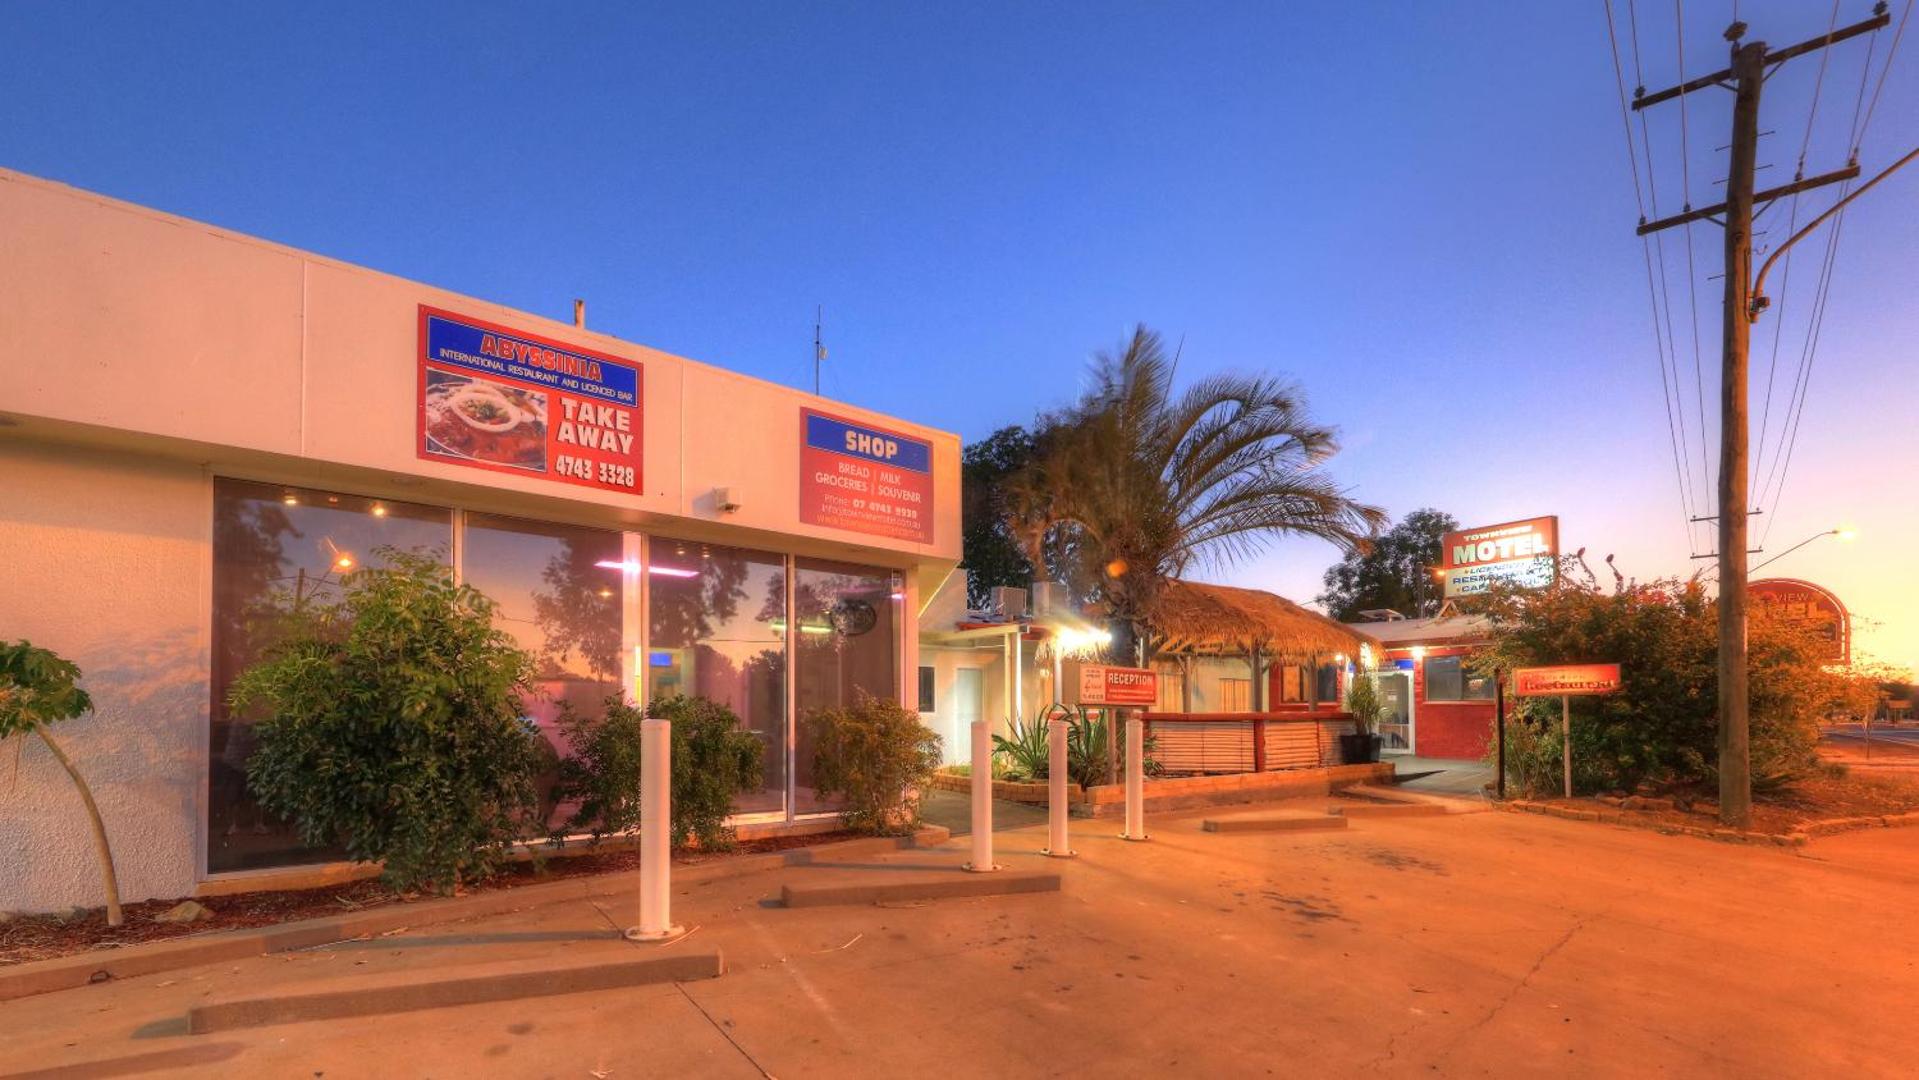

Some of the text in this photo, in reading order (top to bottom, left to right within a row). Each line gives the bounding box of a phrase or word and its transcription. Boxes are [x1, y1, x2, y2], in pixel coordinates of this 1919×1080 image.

[439, 347, 506, 372] INTERNATIONAL
[507, 364, 559, 384] RESTAURANT
[561, 377, 579, 389] AND
[617, 390, 633, 402] BAR
[480, 334, 602, 382] ABYSSINIA
[560, 397, 631, 432] TAKE
[557, 420, 634, 455] AWAY
[845, 430, 898, 459] SHOP
[556, 454, 634, 487] 4743 3328
[838, 461, 902, 486] BREAD MILK
[815, 471, 922, 504] GROCERIES SOUVENIR
[1453, 532, 1550, 565] MOTEL
[1108, 672, 1154, 686] RECEPTION
